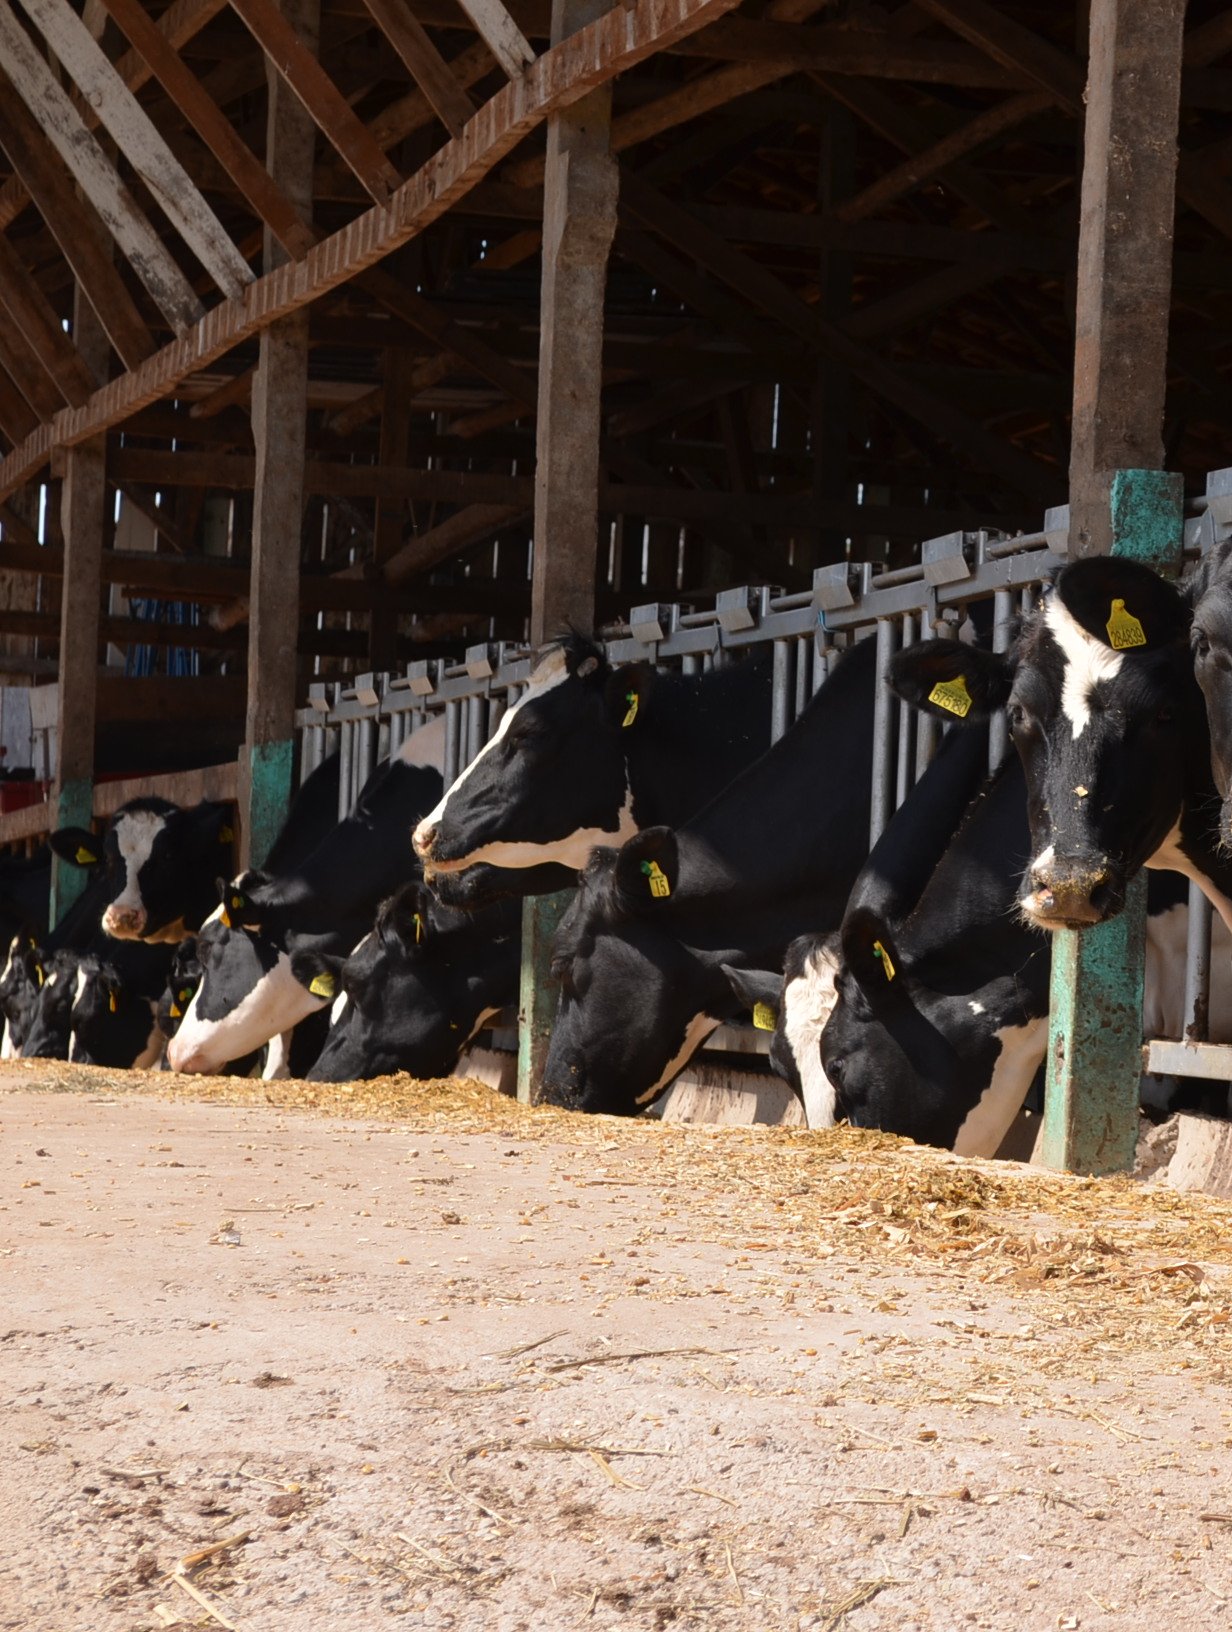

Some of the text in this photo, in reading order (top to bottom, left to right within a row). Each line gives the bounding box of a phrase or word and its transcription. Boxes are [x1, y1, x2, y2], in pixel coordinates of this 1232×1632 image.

[1110, 627, 1144, 647] 284839
[933, 689, 968, 715] 675180
[655, 880, 667, 895] 15
